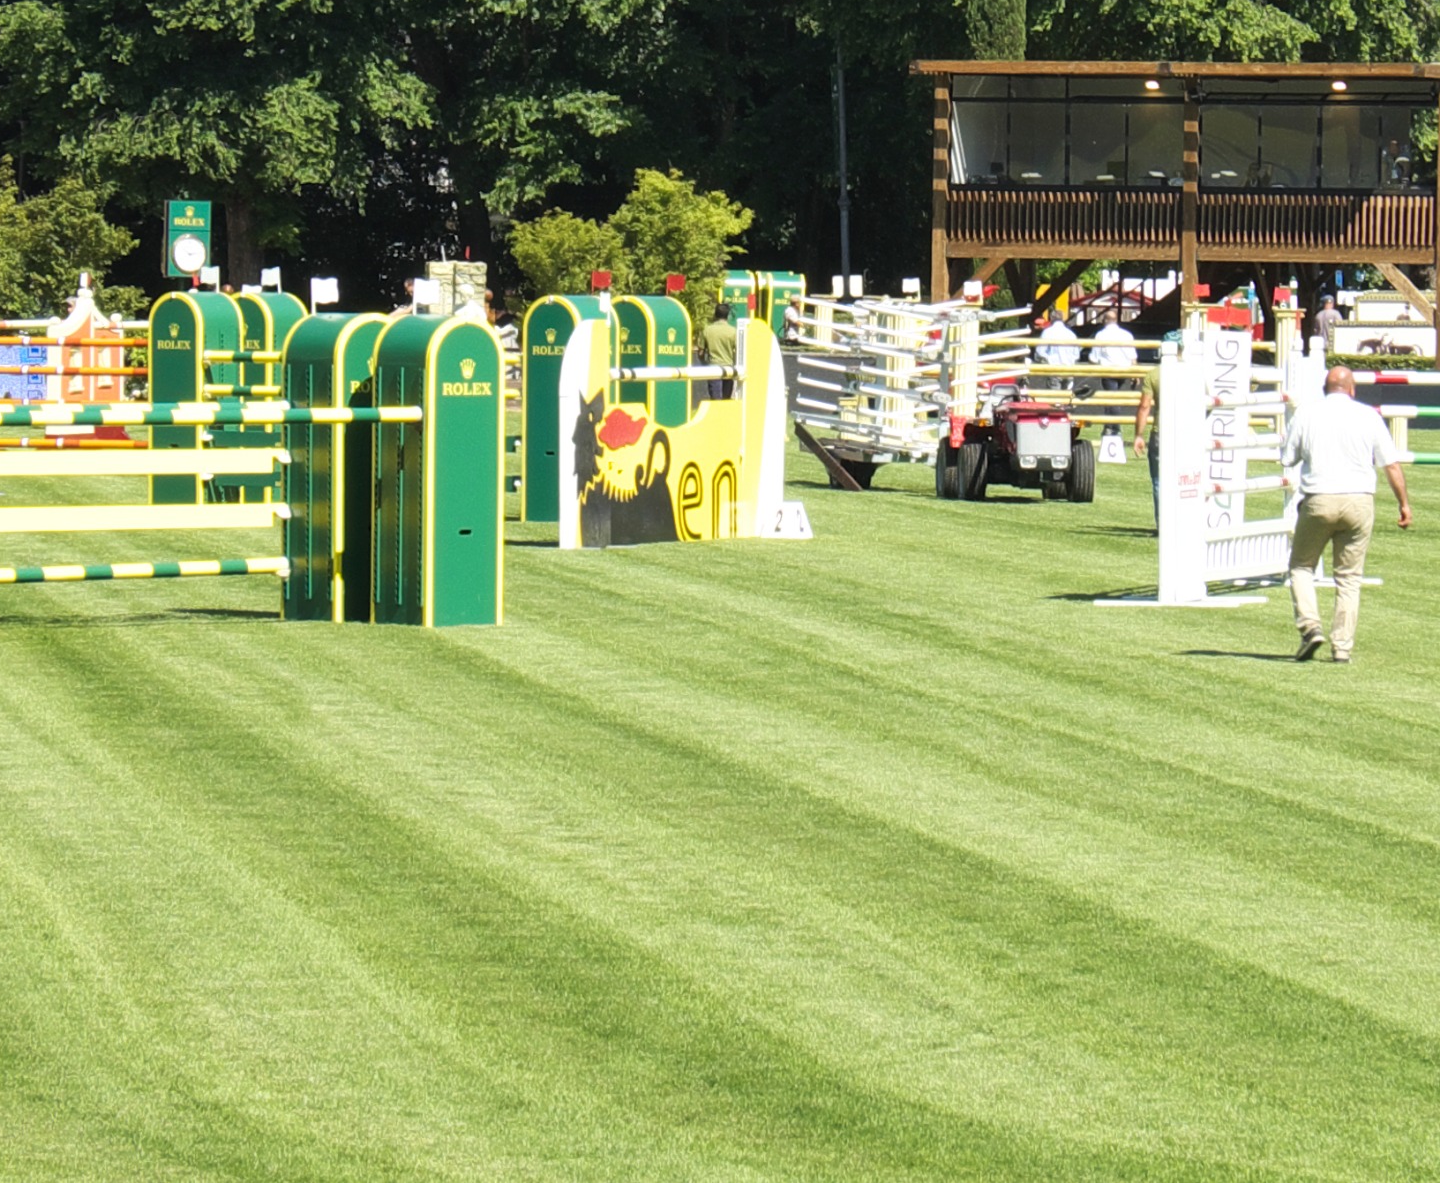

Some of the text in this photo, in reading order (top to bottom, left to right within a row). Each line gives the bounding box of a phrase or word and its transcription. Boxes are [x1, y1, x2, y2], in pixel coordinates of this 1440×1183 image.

[174, 218, 205, 227] ROLEX
[157, 339, 192, 351] ROLEX
[658, 345, 685, 356] ROLEX
[442, 382, 493, 397] ROLEX
[1107, 441, 1117, 458] C
[774, 508, 784, 533] 2
